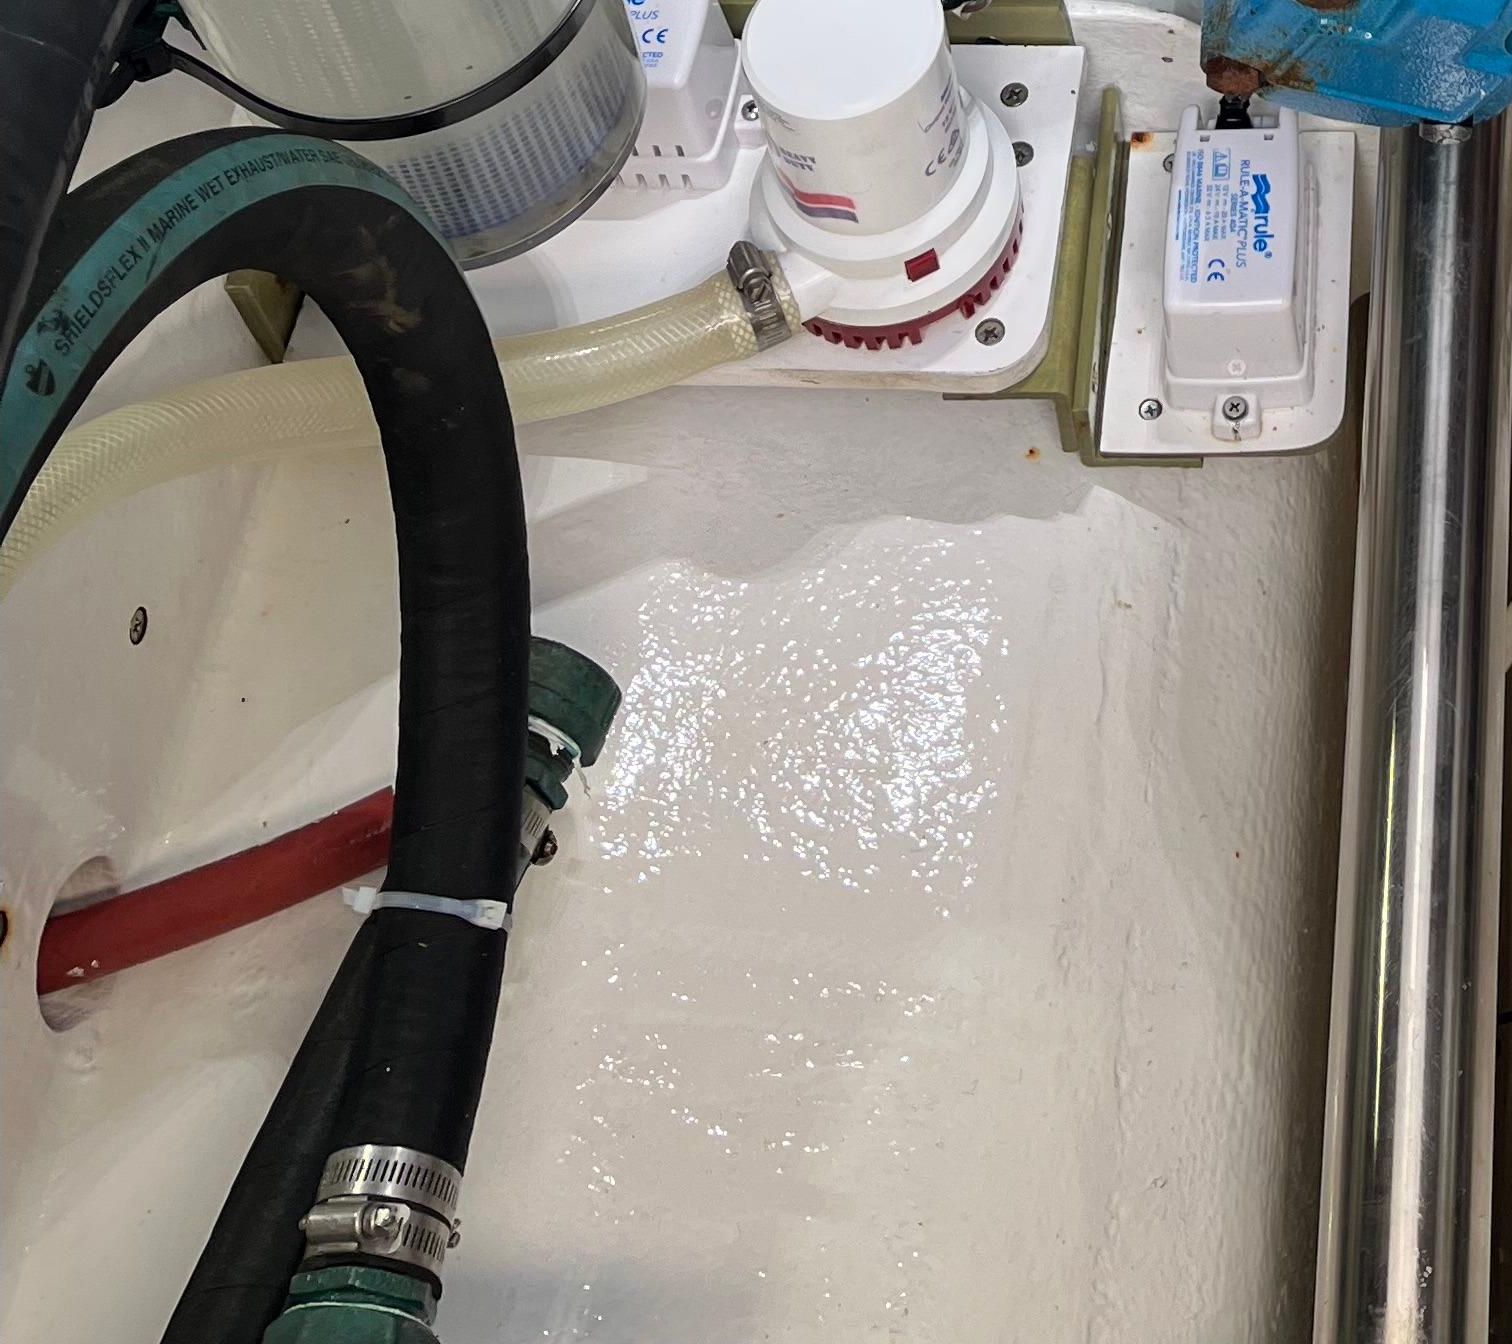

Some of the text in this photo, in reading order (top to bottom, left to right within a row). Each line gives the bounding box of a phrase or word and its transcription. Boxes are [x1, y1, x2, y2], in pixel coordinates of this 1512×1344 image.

[54, 244, 143, 356] SHIELDSFLEX
[149, 194, 200, 244] MARINE
[195, 174, 228, 206] WET
[227, 148, 320, 188] EXHAUST/WATER
[1236, 239, 1248, 268] PLUS
